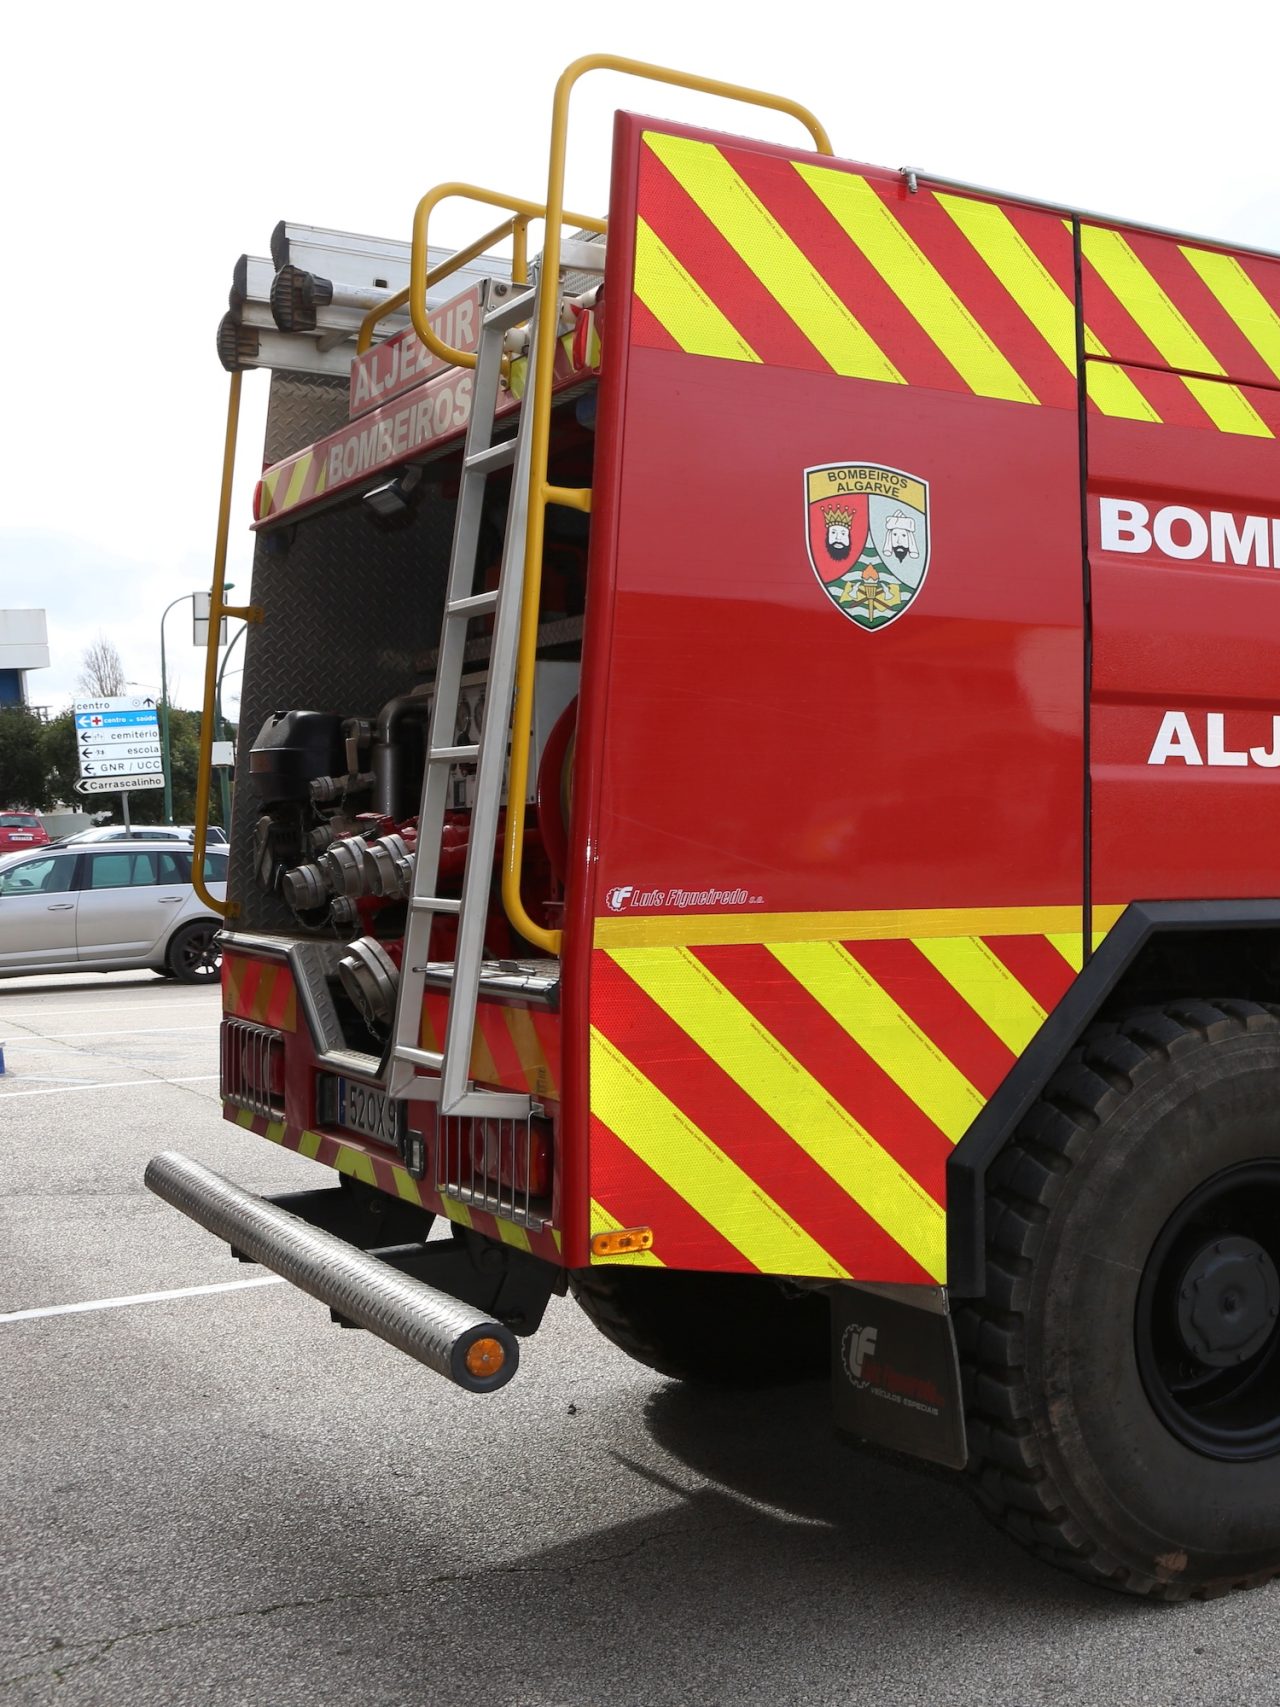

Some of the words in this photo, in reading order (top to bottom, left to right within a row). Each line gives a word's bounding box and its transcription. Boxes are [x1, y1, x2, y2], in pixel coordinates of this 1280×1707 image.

[328, 376, 473, 487] BOMBEIROS
[827, 469, 908, 489] BOMBEIROS
[836, 481, 901, 498] ALGARVE
[76, 702, 110, 710] centro
[127, 746, 159, 755] escola
[100, 762, 125, 772] GNR
[137, 760, 160, 770] UCC
[90, 778, 162, 790] Carrascalinho
[665, 888, 748, 908] Figueiredo
